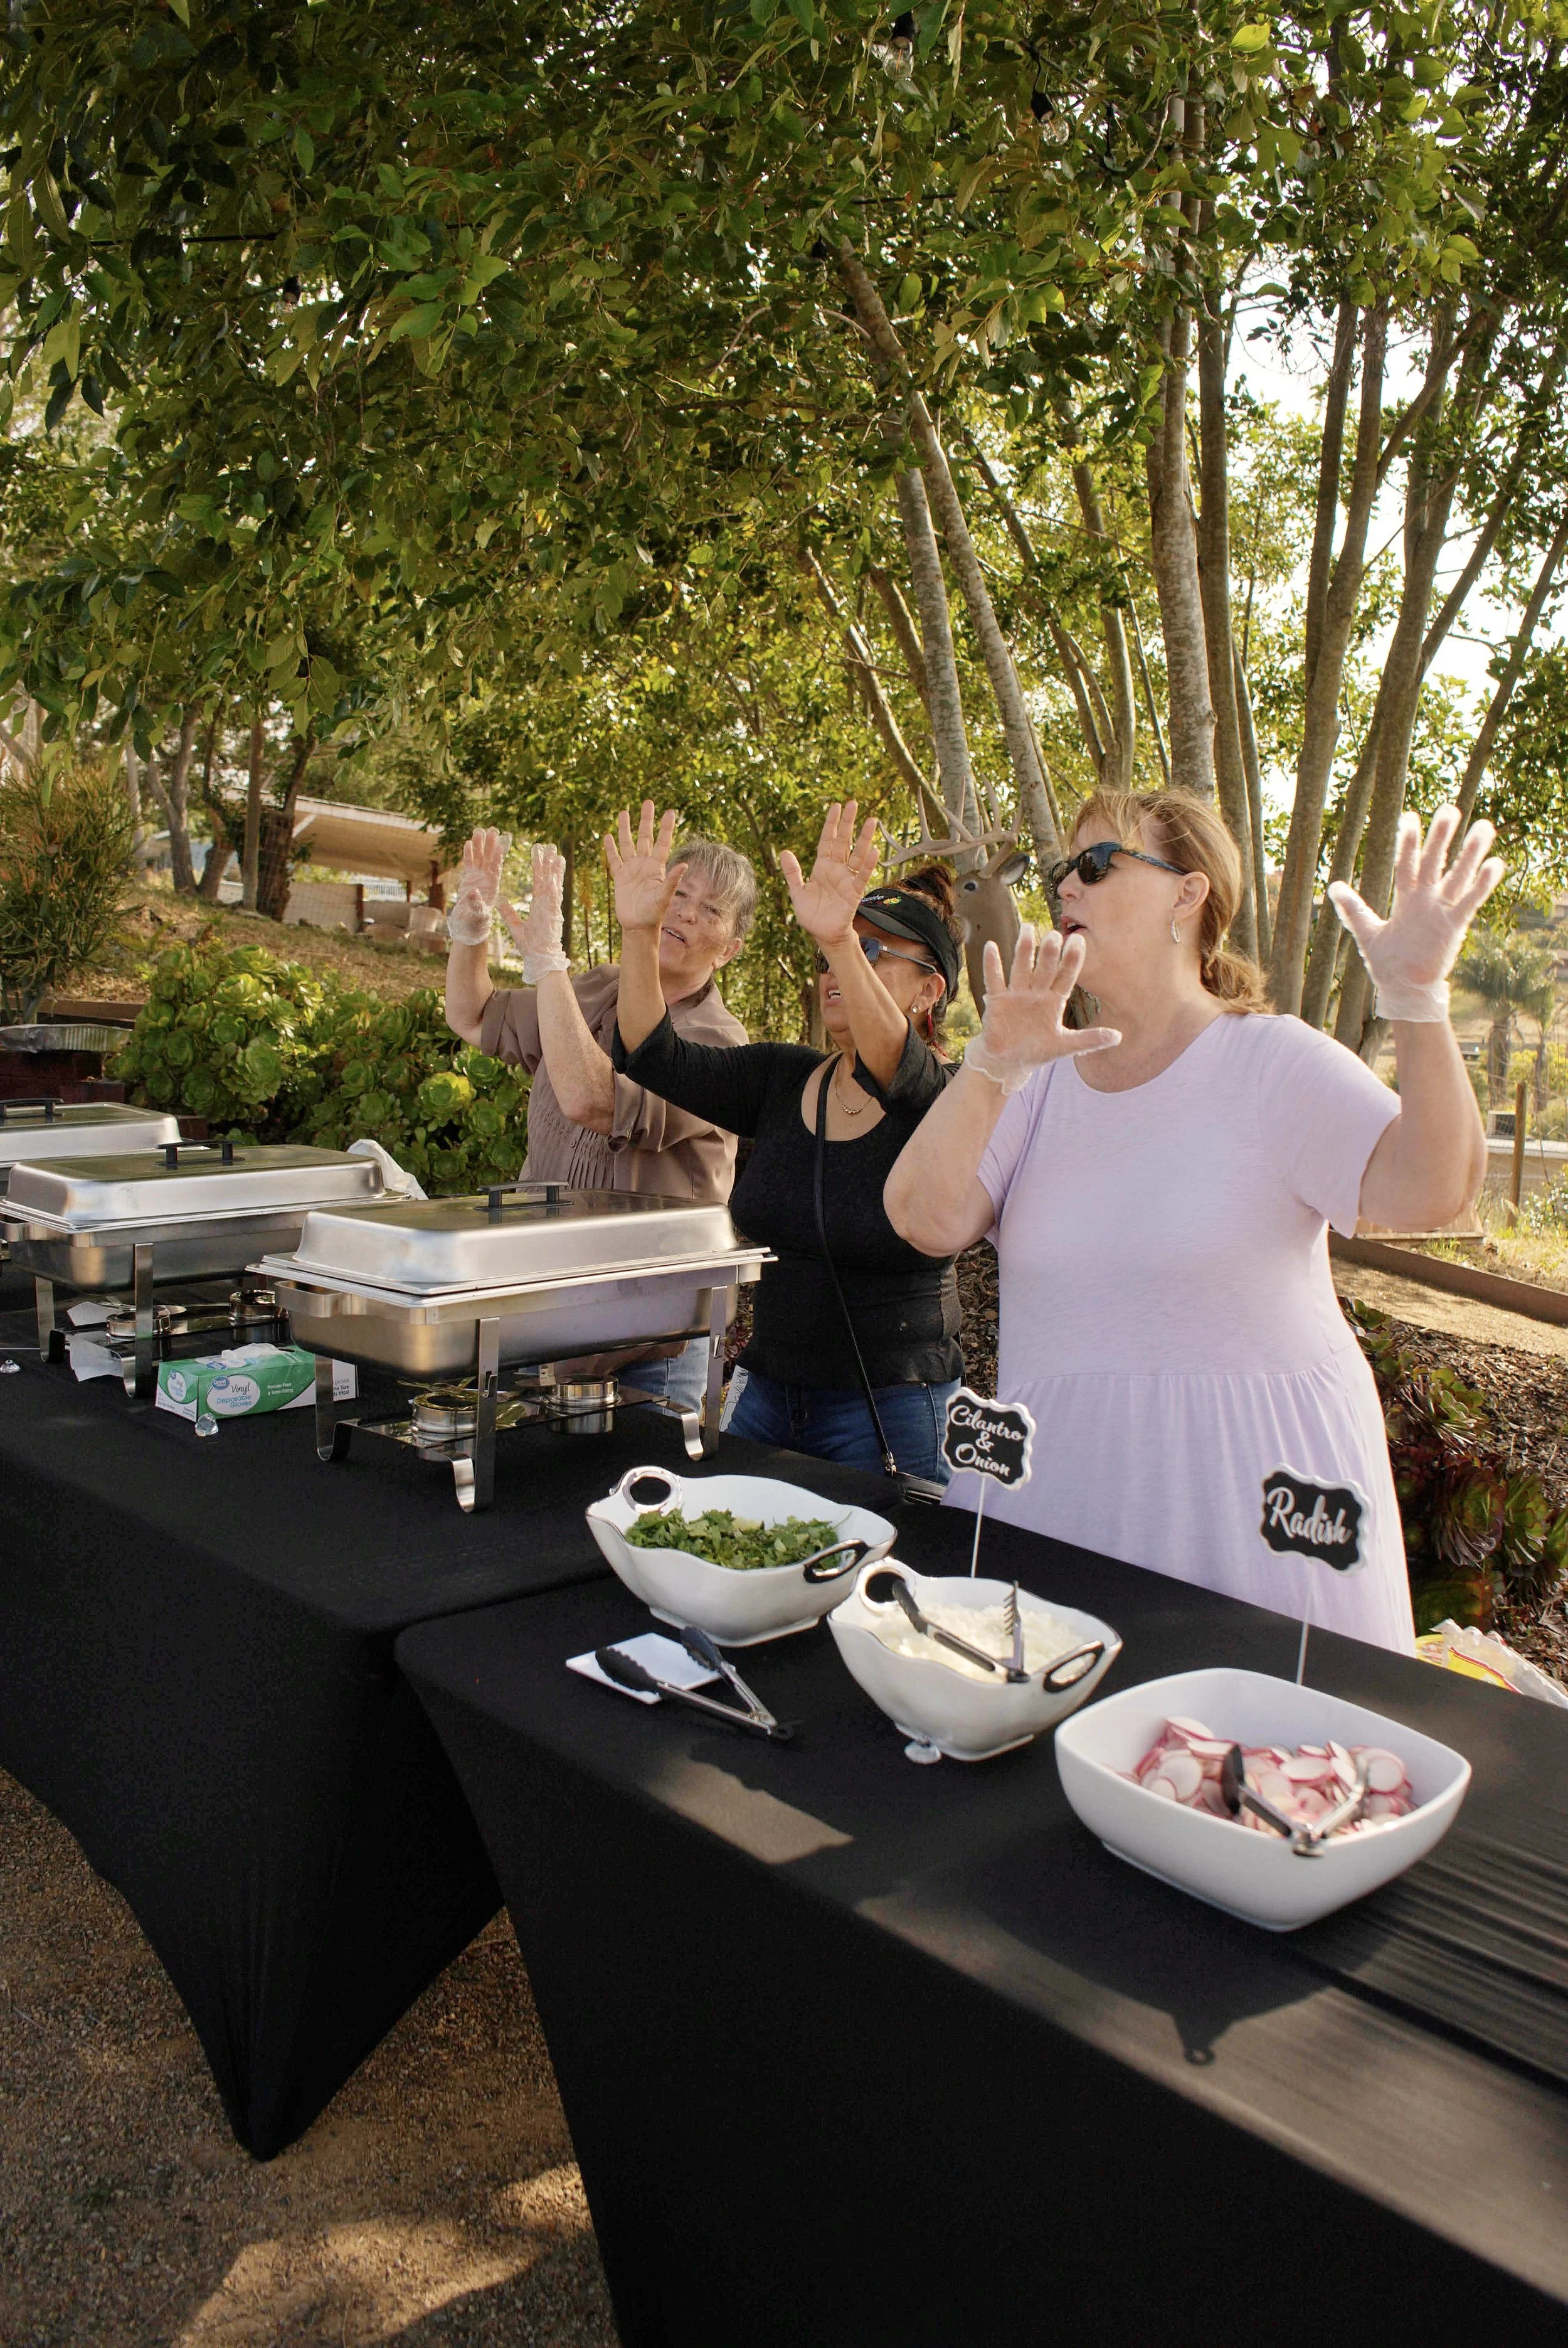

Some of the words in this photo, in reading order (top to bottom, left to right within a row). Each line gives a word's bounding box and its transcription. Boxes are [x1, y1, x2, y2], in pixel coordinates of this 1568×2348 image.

[216, 1394, 252, 1404] Disposable
[231, 1381, 250, 1395] Vinyl
[950, 1405, 1024, 1441] Cilantro
[975, 1431, 995, 1453] &
[955, 1443, 1010, 1476] Onion
[1267, 1487, 1353, 1545] Radish
